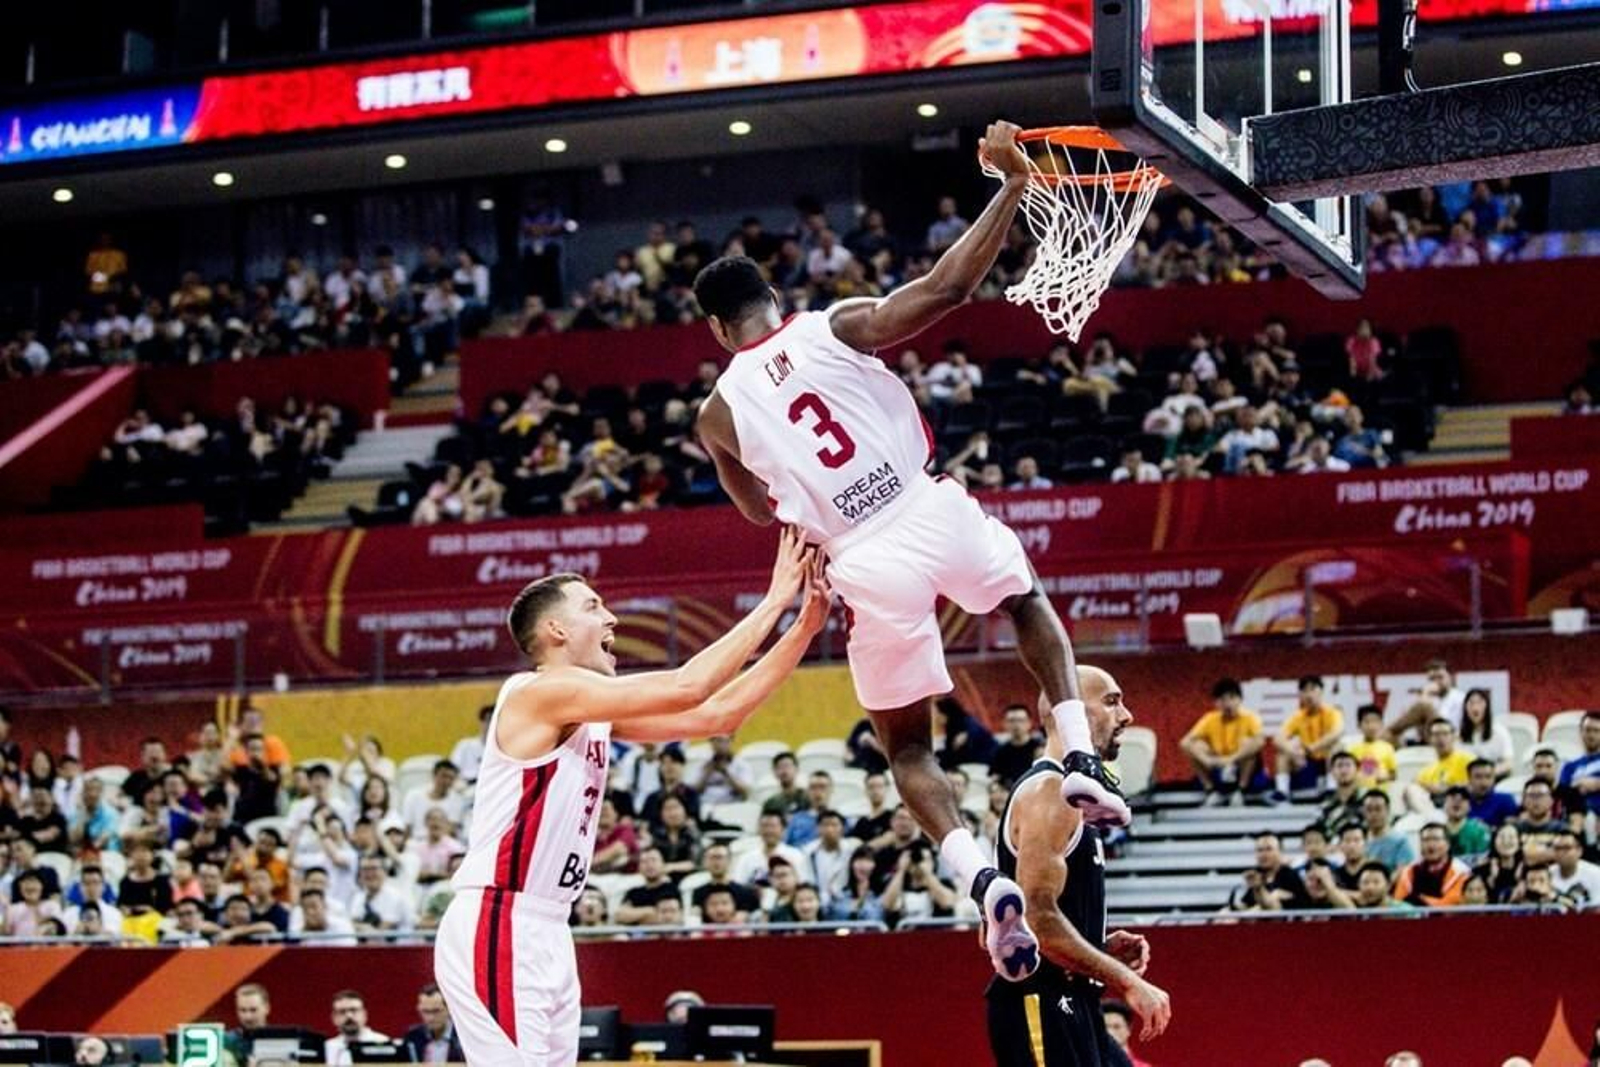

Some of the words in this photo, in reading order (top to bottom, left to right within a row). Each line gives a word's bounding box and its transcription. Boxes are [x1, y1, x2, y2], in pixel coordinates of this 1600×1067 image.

[765, 350, 795, 387] EJIM
[788, 392, 856, 469] 3
[832, 461, 894, 509] DREAM
[842, 475, 902, 519] MAKER
[1379, 476, 1487, 501] BASKETBALL
[1488, 471, 1550, 494] WORLD
[1553, 469, 1589, 491] CUP
[1007, 499, 1066, 521] WORLD
[1068, 497, 1102, 519] CUP
[1394, 504, 1472, 534] China
[1477, 498, 1535, 527] 2019
[477, 555, 545, 583] China
[76, 580, 137, 606] China
[1068, 596, 1130, 620] China
